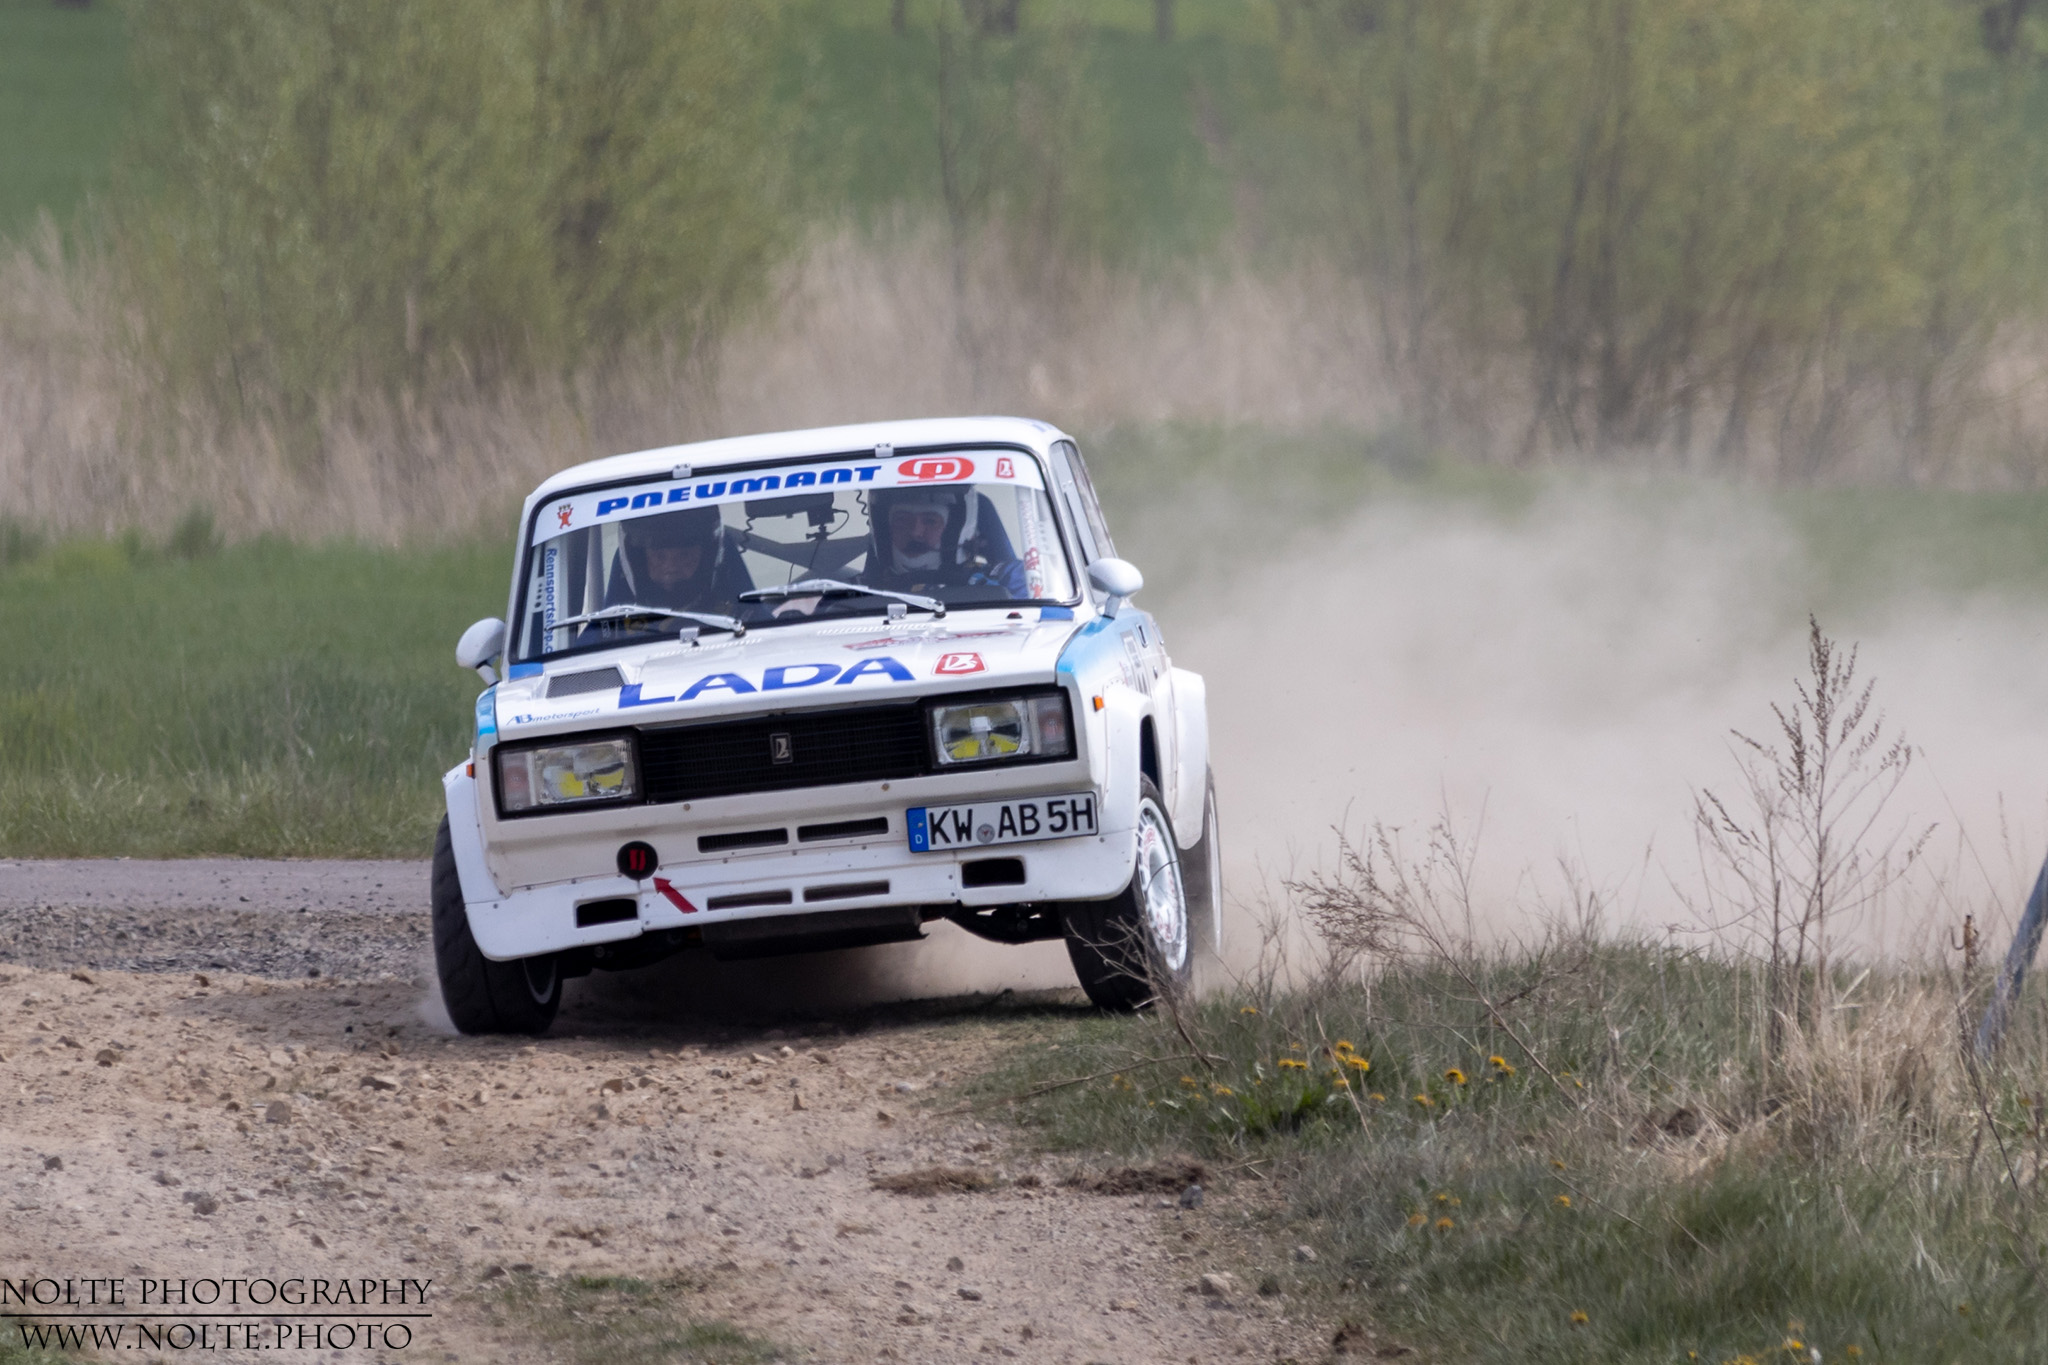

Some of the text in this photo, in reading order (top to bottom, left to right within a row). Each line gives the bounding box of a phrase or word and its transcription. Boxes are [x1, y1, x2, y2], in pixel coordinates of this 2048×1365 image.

[596, 465, 882, 517] PNEUMANT
[618, 656, 916, 708] LADA
[929, 808, 973, 845] KW
